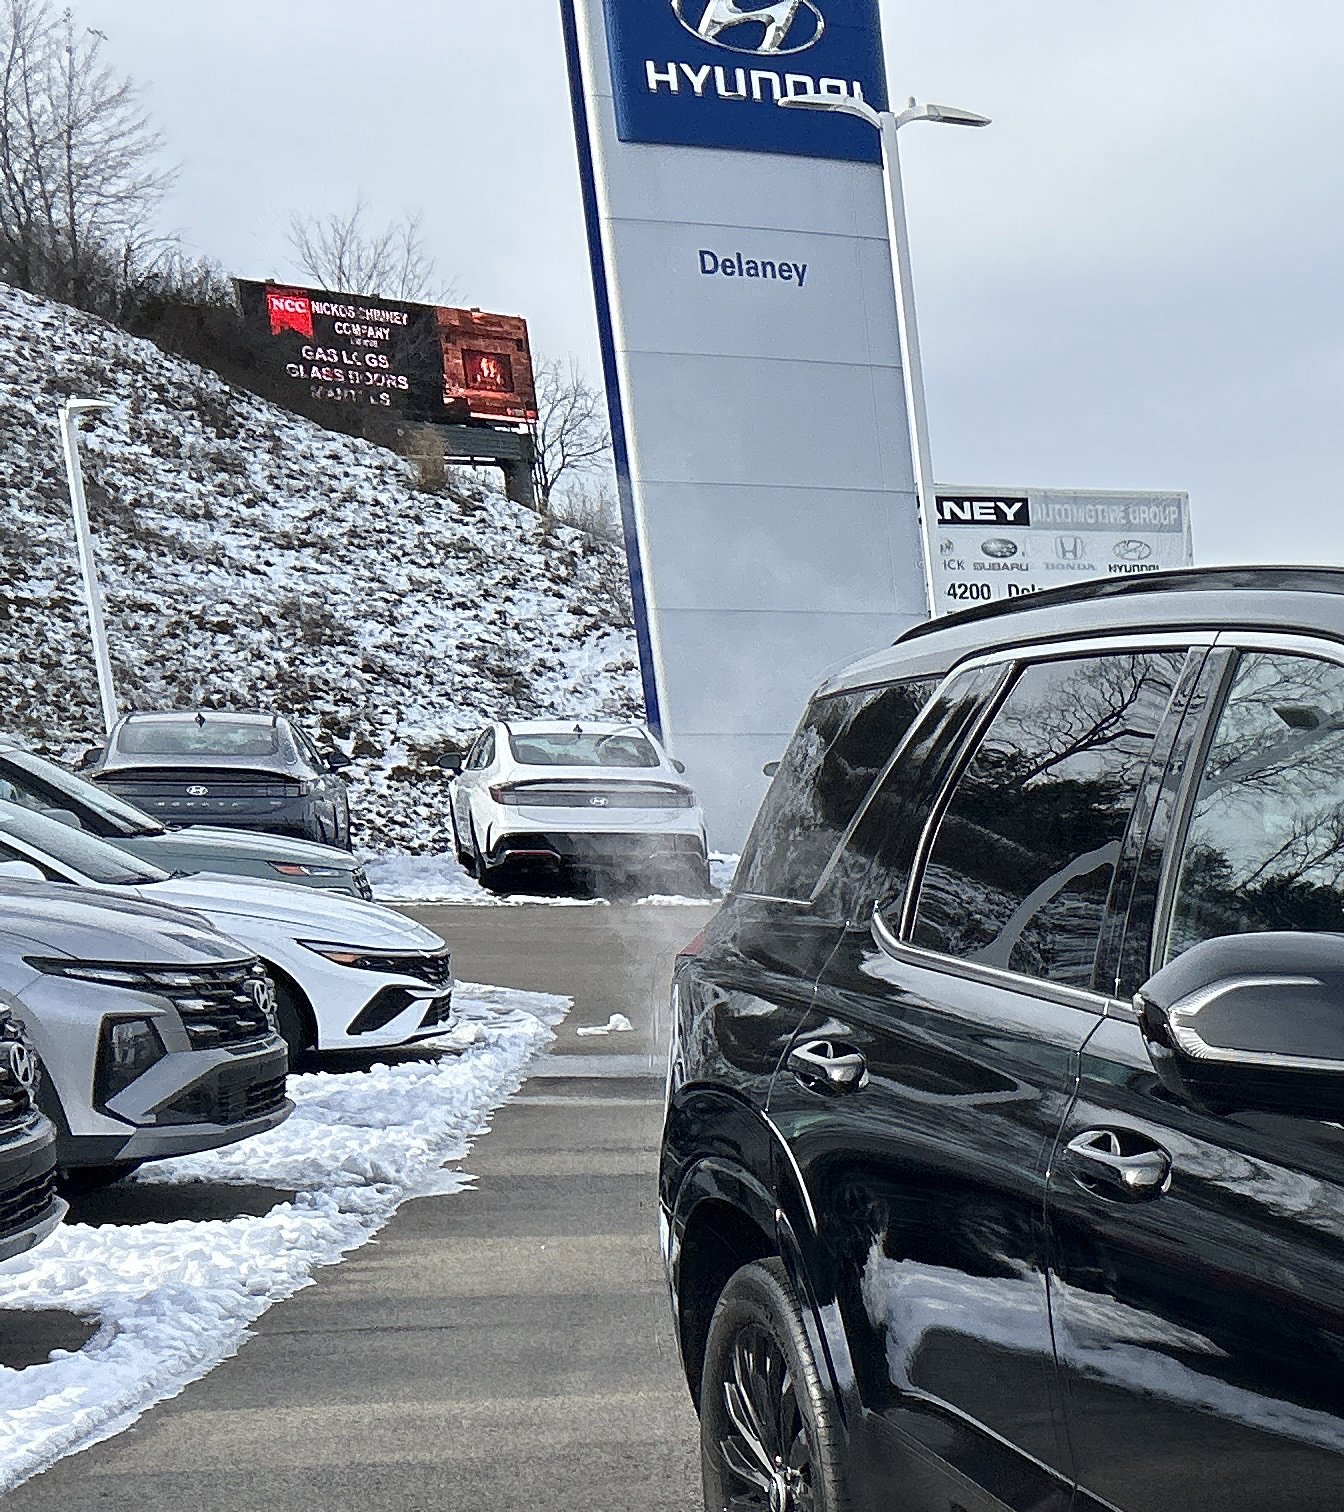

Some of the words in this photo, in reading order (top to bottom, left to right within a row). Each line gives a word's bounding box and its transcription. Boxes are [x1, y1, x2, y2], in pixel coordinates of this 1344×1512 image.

[645, 60, 864, 103] HYUNDAI
[699, 249, 808, 287] Delaney
[271, 298, 307, 313] NCC
[301, 345, 339, 363] GAS
[285, 363, 345, 382] GLASS
[938, 500, 1022, 521] NEY
[972, 561, 1029, 572] SUBARU
[1108, 563, 1160, 573] HYUNDAI
[946, 583, 991, 600] 4200
